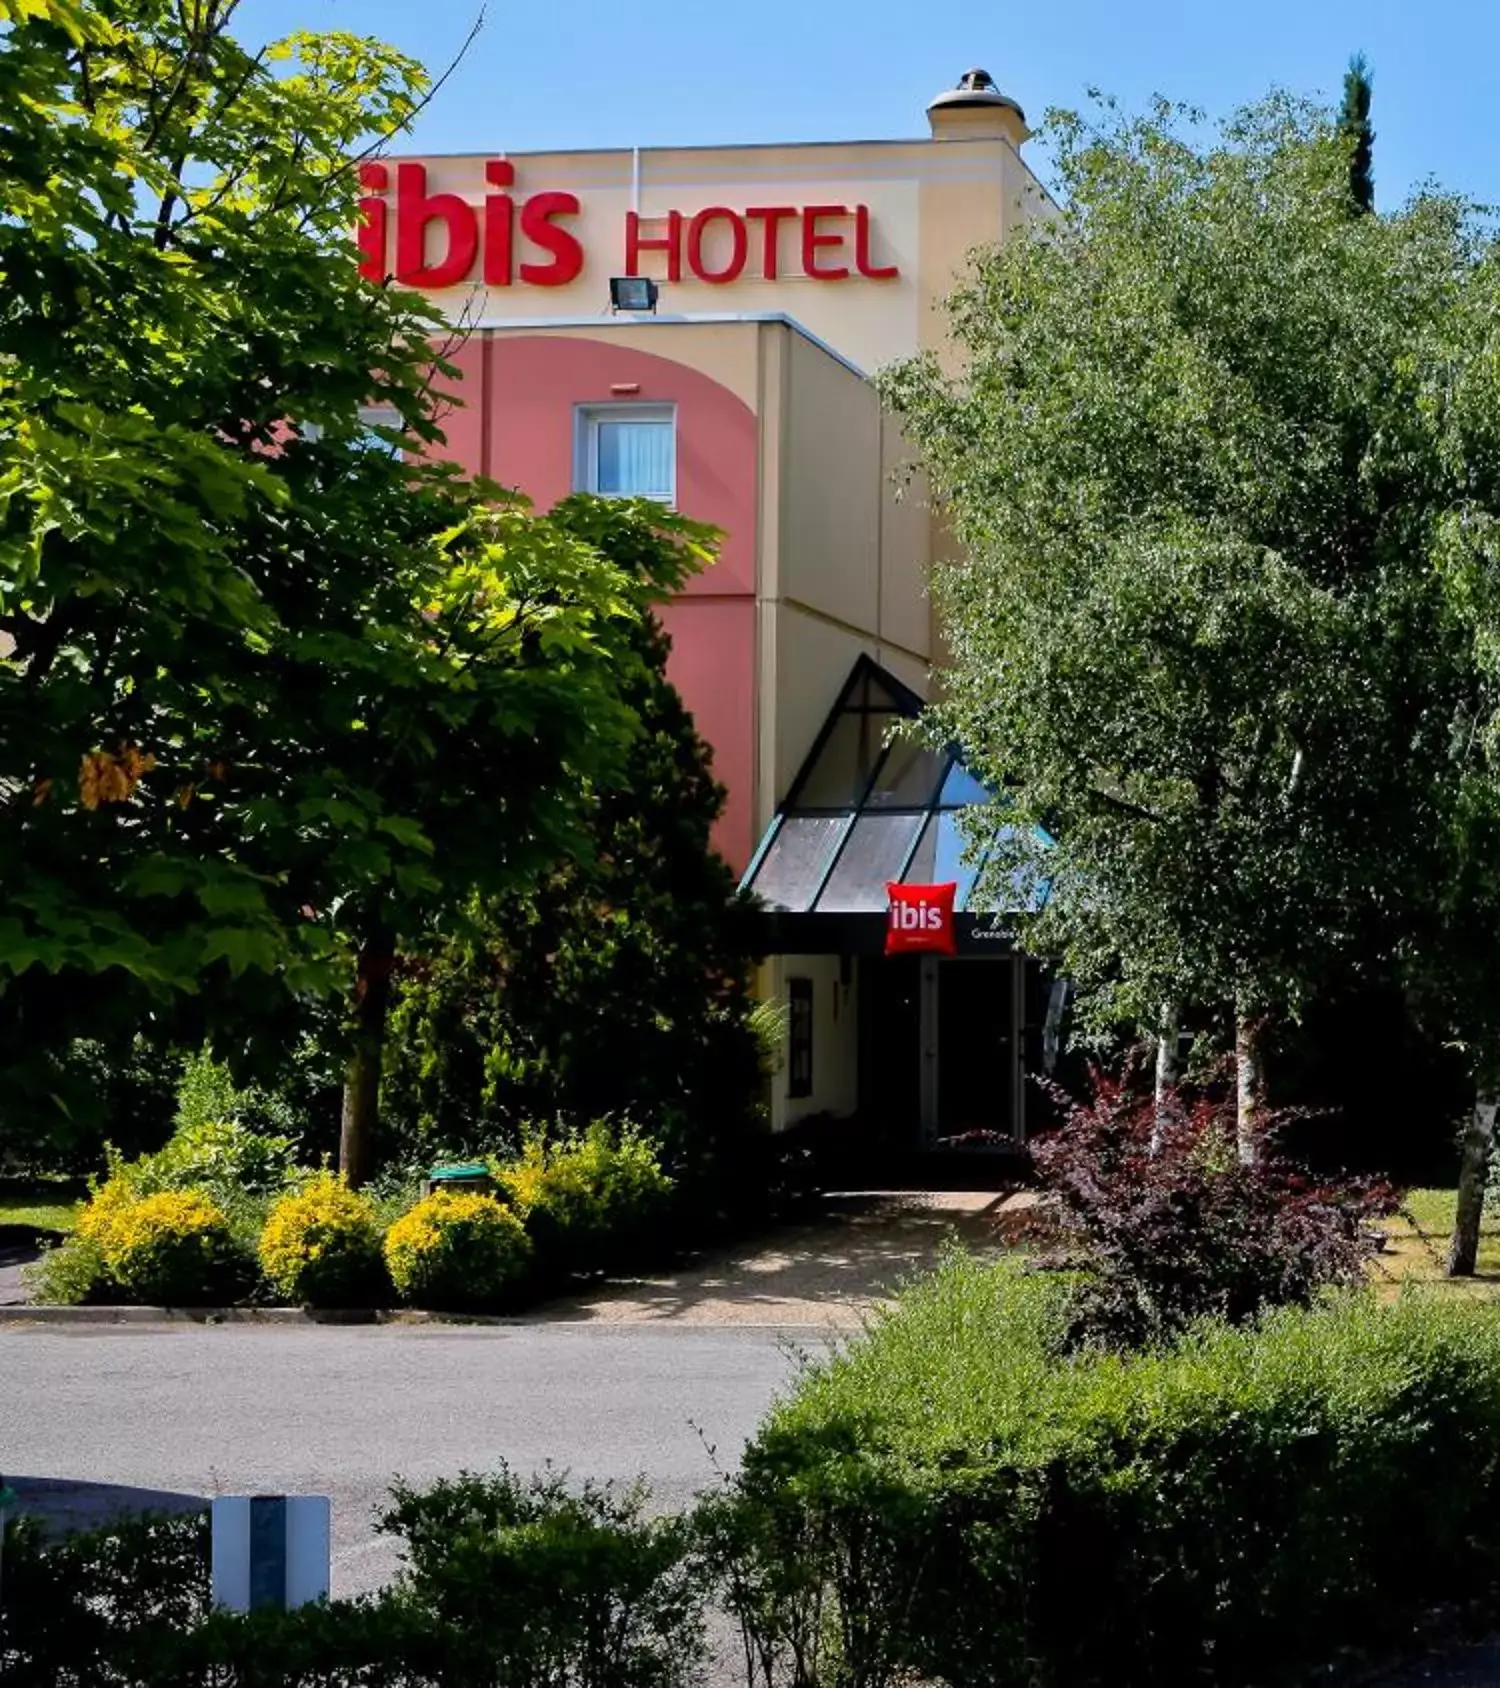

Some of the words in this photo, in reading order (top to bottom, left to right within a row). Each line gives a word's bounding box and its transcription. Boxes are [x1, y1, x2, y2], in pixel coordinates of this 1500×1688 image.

[357, 160, 583, 287] ibis
[626, 204, 898, 283] HOTEL
[892, 901, 943, 930] ibis
